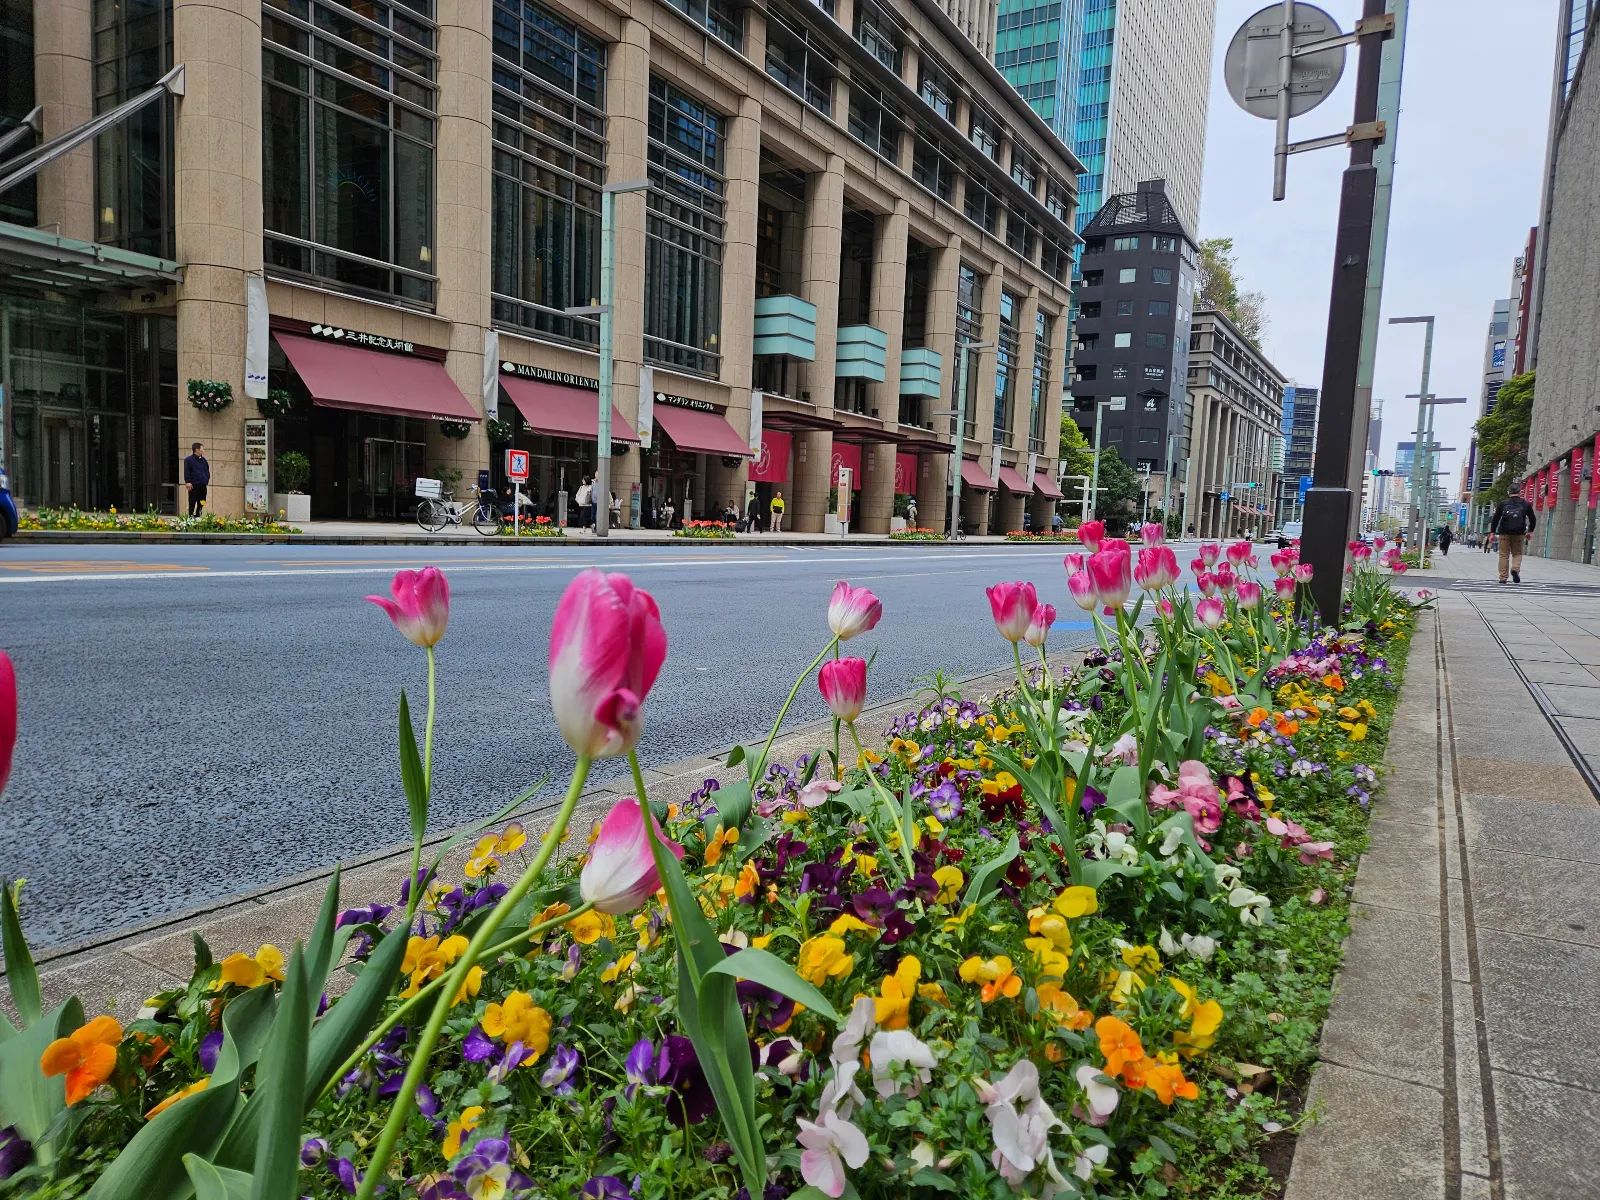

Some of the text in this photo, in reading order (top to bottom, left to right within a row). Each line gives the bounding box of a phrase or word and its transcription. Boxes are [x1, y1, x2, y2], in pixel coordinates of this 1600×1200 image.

[517, 364, 599, 389] MANDARIN ORIENTA
[1574, 458, 1582, 484] YUITO
